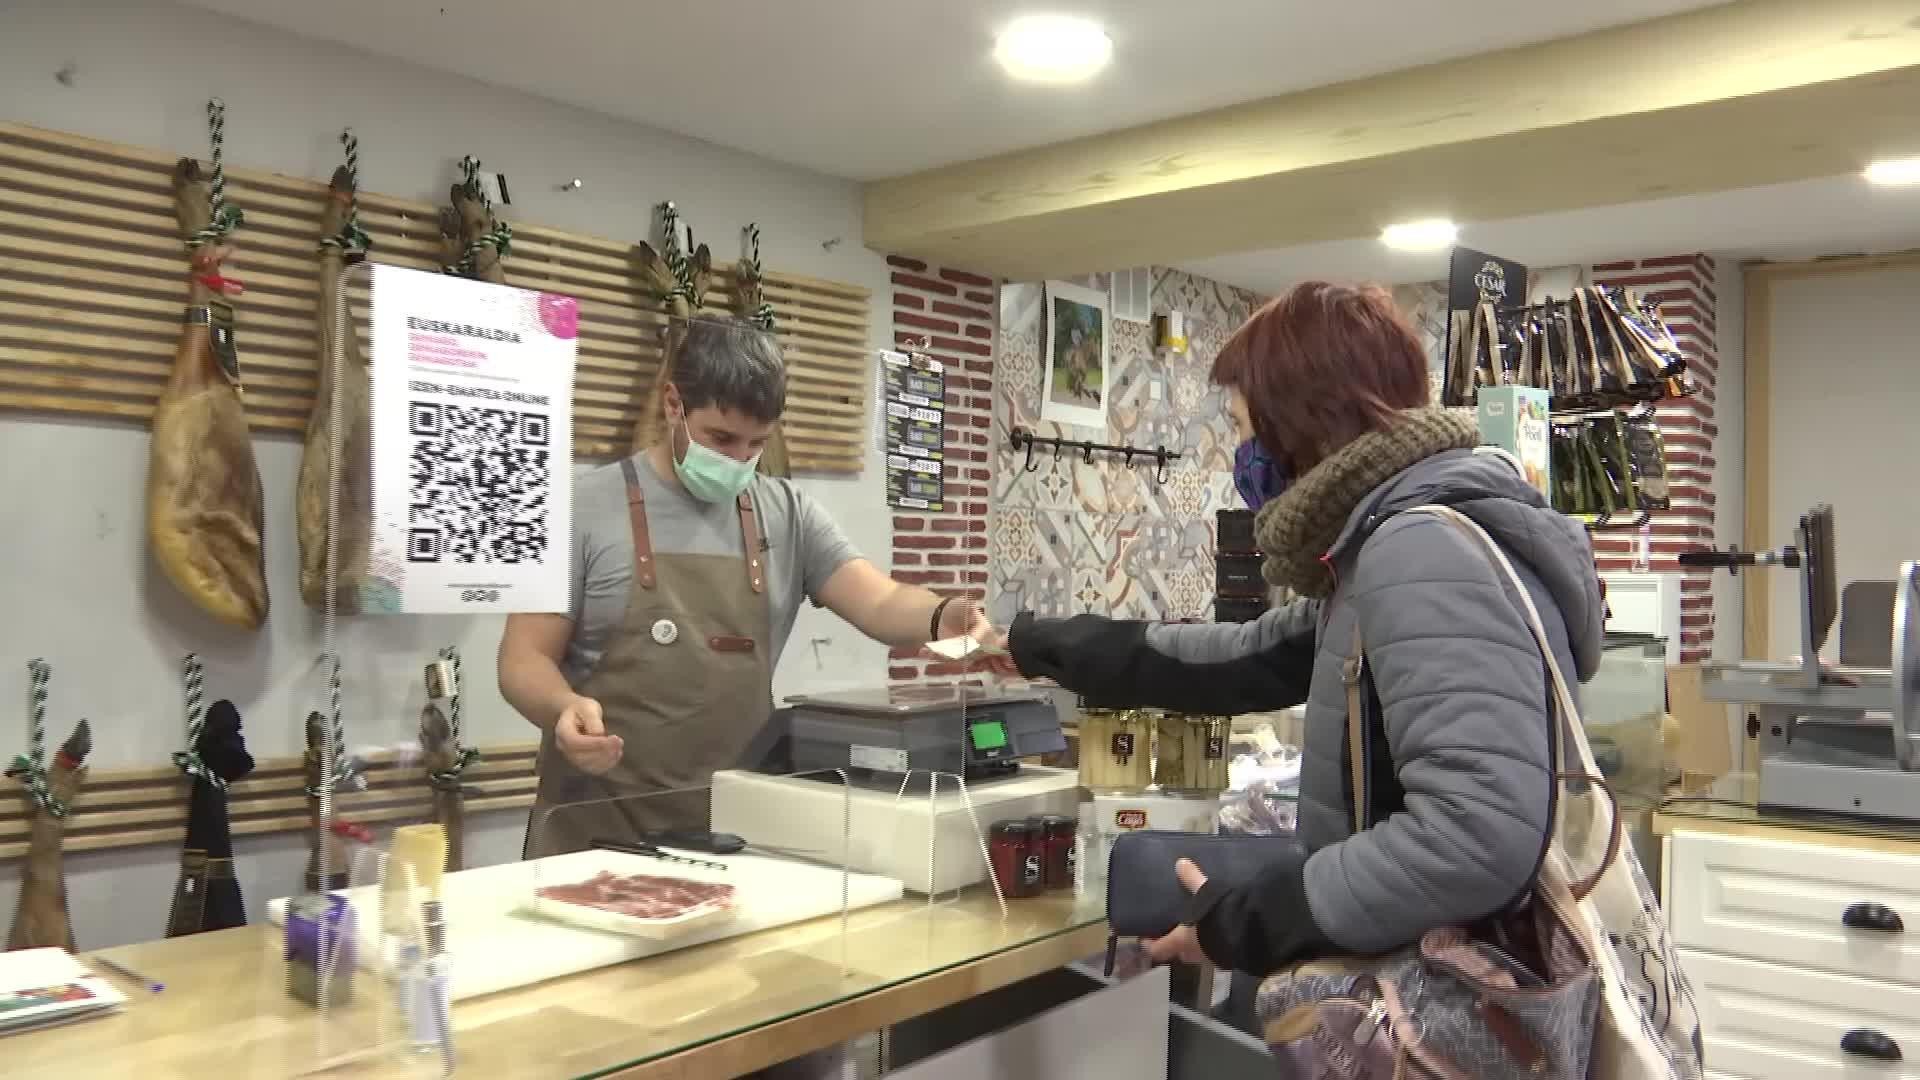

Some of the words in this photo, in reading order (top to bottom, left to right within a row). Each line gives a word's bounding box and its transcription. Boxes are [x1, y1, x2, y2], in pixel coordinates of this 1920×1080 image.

[408, 316, 522, 343] EUSKARALDIA
[408, 380, 503, 400] IZEN-EMATEA
[504, 392, 550, 406] ONLINE
